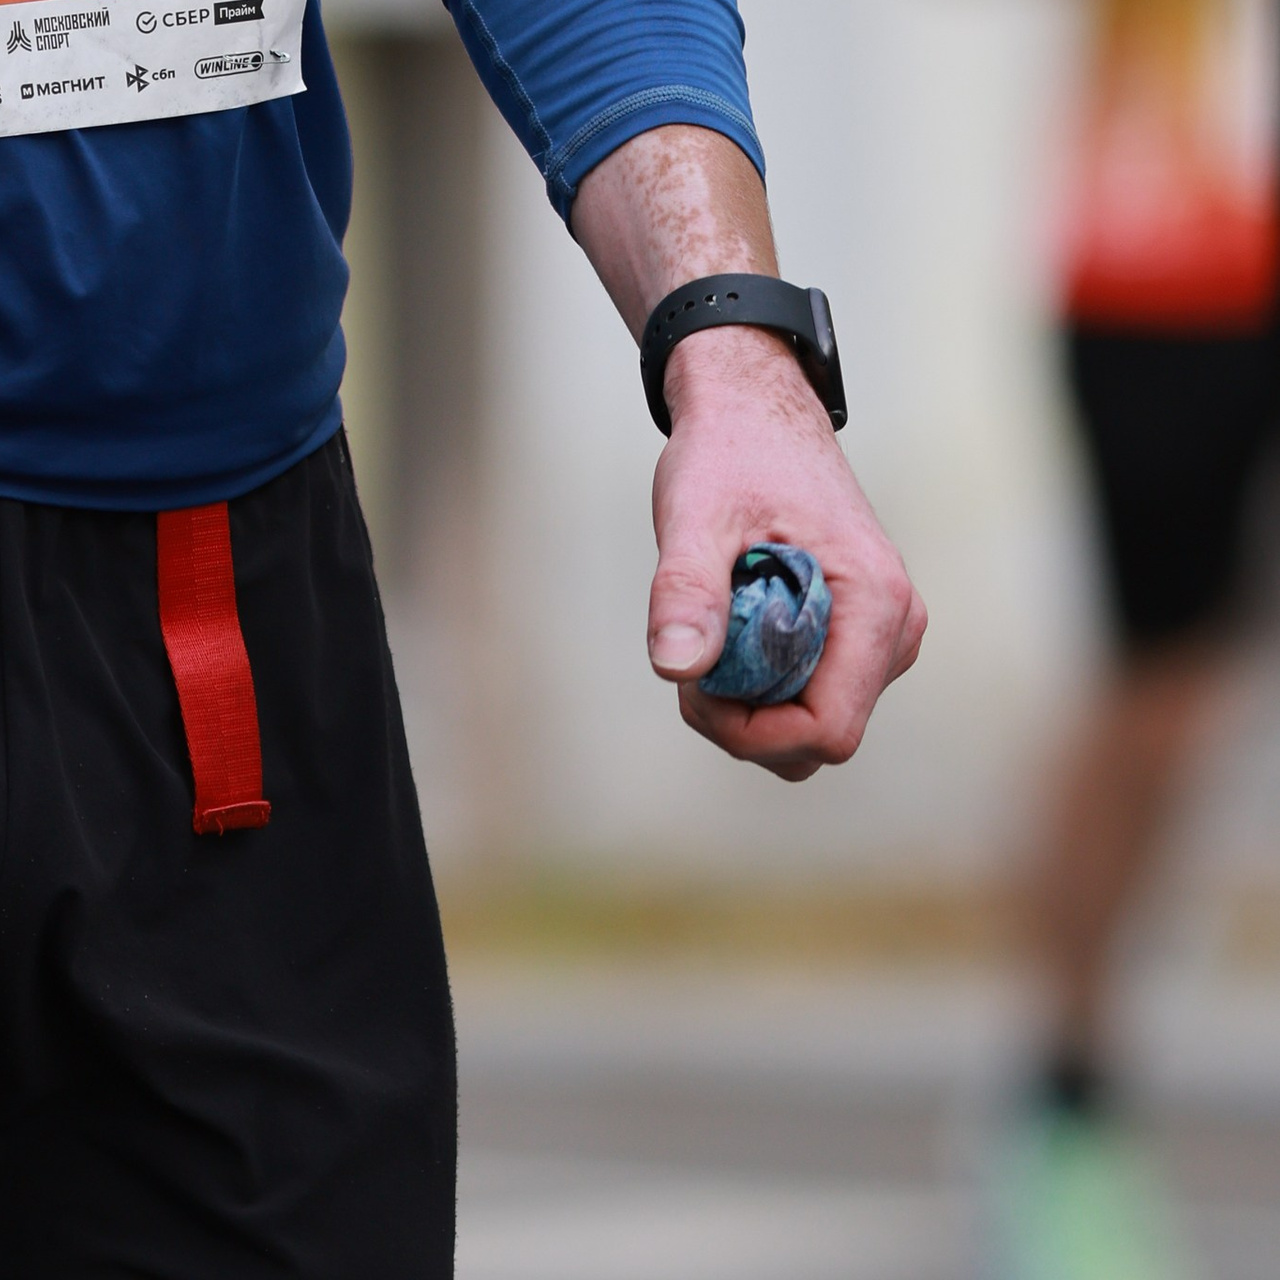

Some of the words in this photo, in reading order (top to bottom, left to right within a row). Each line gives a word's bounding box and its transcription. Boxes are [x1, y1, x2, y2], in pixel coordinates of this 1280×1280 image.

[34, 7, 110, 34] МОСКОВСКИЙ
[162, 8, 210, 27] СБЕР
[219, 4, 256, 21] Прайм
[35, 32, 69, 52] СПОРТ
[151, 68, 176, 81] сбп
[200, 57, 250, 75] WINLINE
